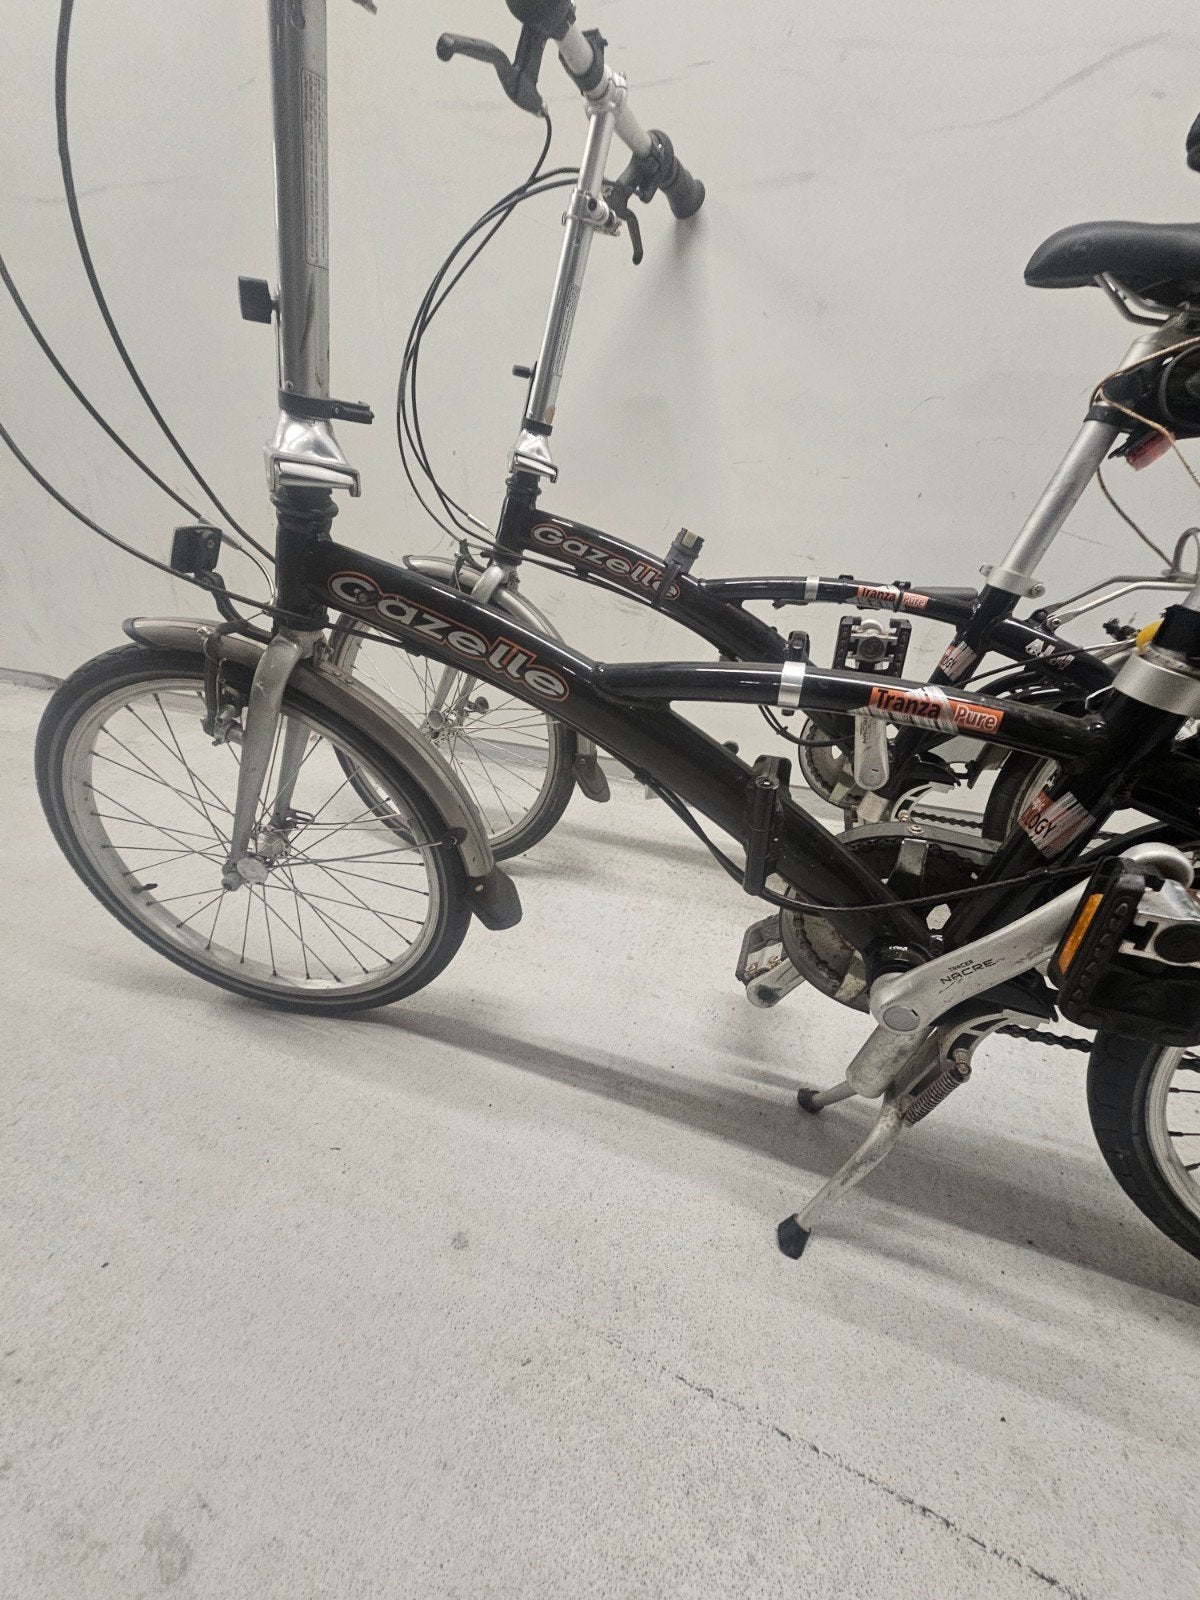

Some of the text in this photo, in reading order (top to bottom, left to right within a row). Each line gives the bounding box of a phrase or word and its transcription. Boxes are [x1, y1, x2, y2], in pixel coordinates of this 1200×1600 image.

[862, 587, 897, 602] Tranza
[329, 573, 568, 700] Gazelle
[877, 688, 998, 731] Tranza Pure
[940, 959, 996, 984] NACRE
